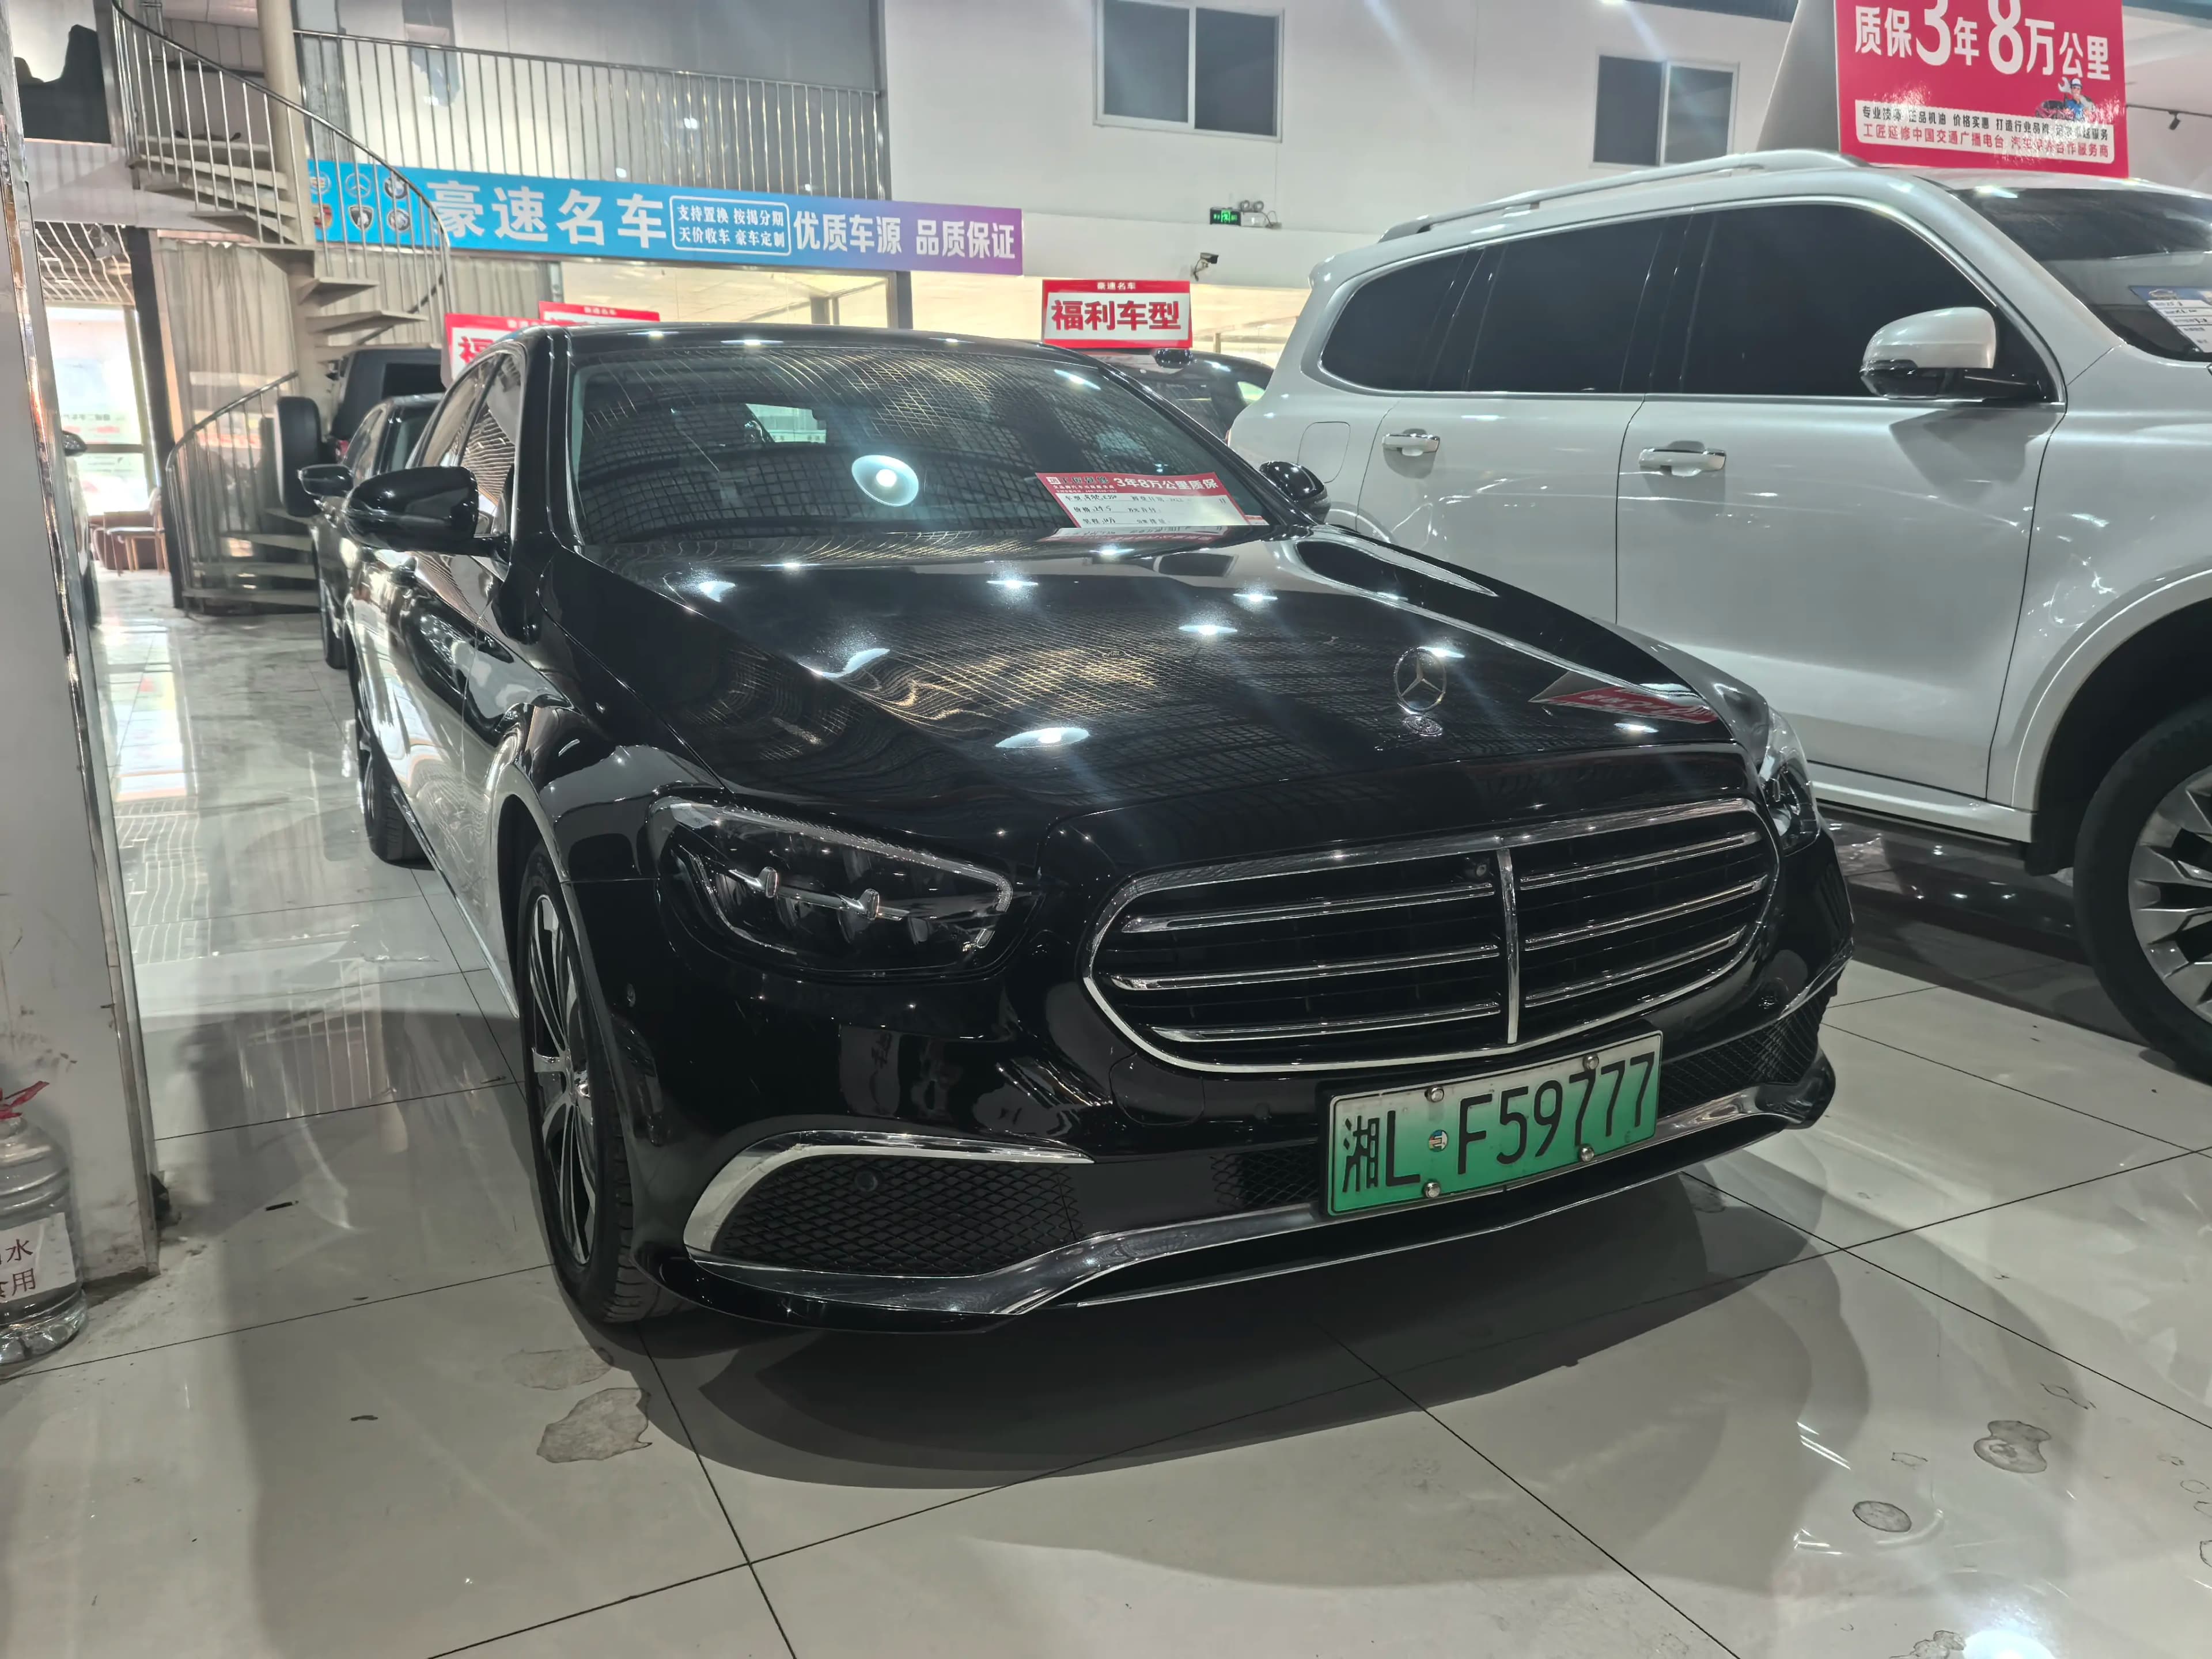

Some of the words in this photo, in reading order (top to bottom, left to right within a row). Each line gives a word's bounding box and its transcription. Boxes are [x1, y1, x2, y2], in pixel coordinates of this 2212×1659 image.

[1953, 113, 1989, 130] 价格实惠
[426, 180, 666, 249] 豪速名车
[677, 204, 729, 224] 支持置换
[733, 207, 784, 227] 按揭分期
[679, 226, 730, 245] 天价收车
[735, 229, 785, 248] 豪车定制
[794, 210, 902, 255] 优质车源
[916, 218, 1016, 259] 品质保证
[1051, 300, 1181, 331] 福利车型
[1113, 478, 1219, 490] 3年8万公里质保
[1342, 1110, 1421, 1193] 湘L
[1457, 1052, 1655, 1175] F59777
[0, 1238, 33, 1265] 水
